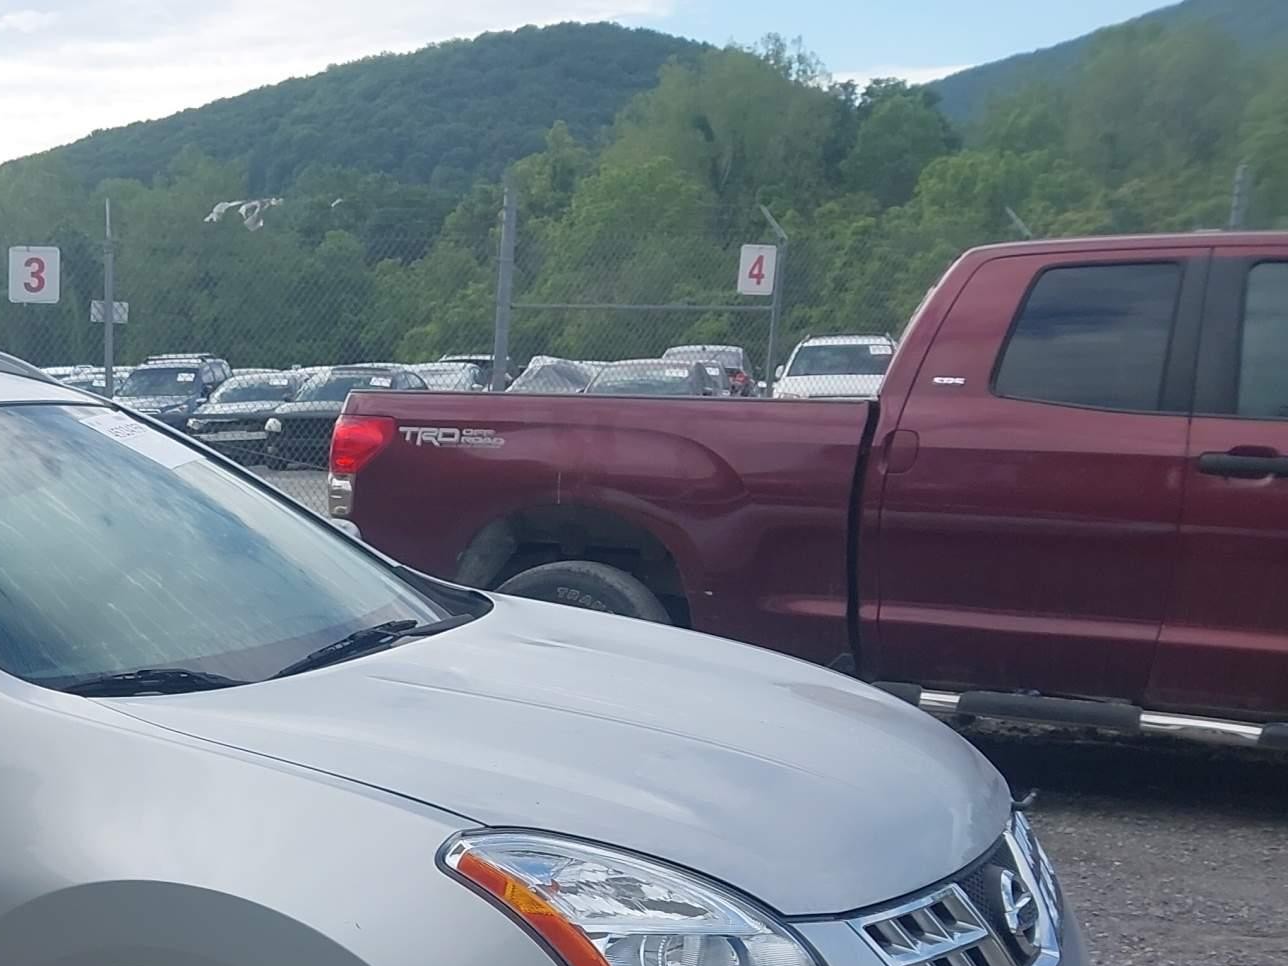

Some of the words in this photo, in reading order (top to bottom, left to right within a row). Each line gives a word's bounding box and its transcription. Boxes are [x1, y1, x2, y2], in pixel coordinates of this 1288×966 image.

[24, 257, 45, 293] 3
[749, 255, 765, 285] 4
[398, 426, 461, 447] TRD
